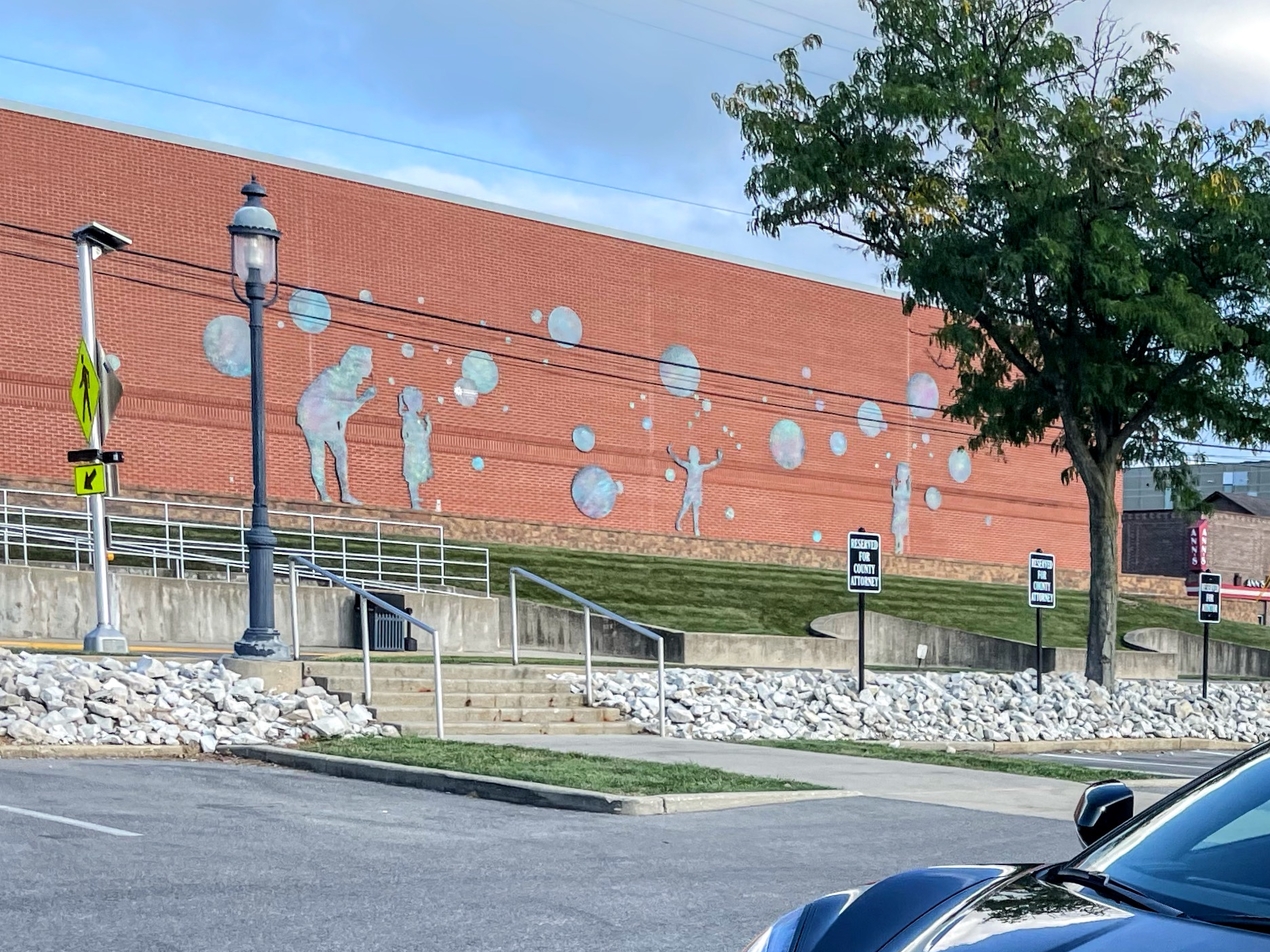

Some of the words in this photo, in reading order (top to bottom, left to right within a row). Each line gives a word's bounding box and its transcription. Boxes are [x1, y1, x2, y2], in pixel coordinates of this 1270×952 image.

[850, 538, 878, 550] RESERVED
[858, 551, 871, 561] FOR
[853, 563, 875, 575] COUNTY
[850, 576, 878, 587] ATTORNEY
